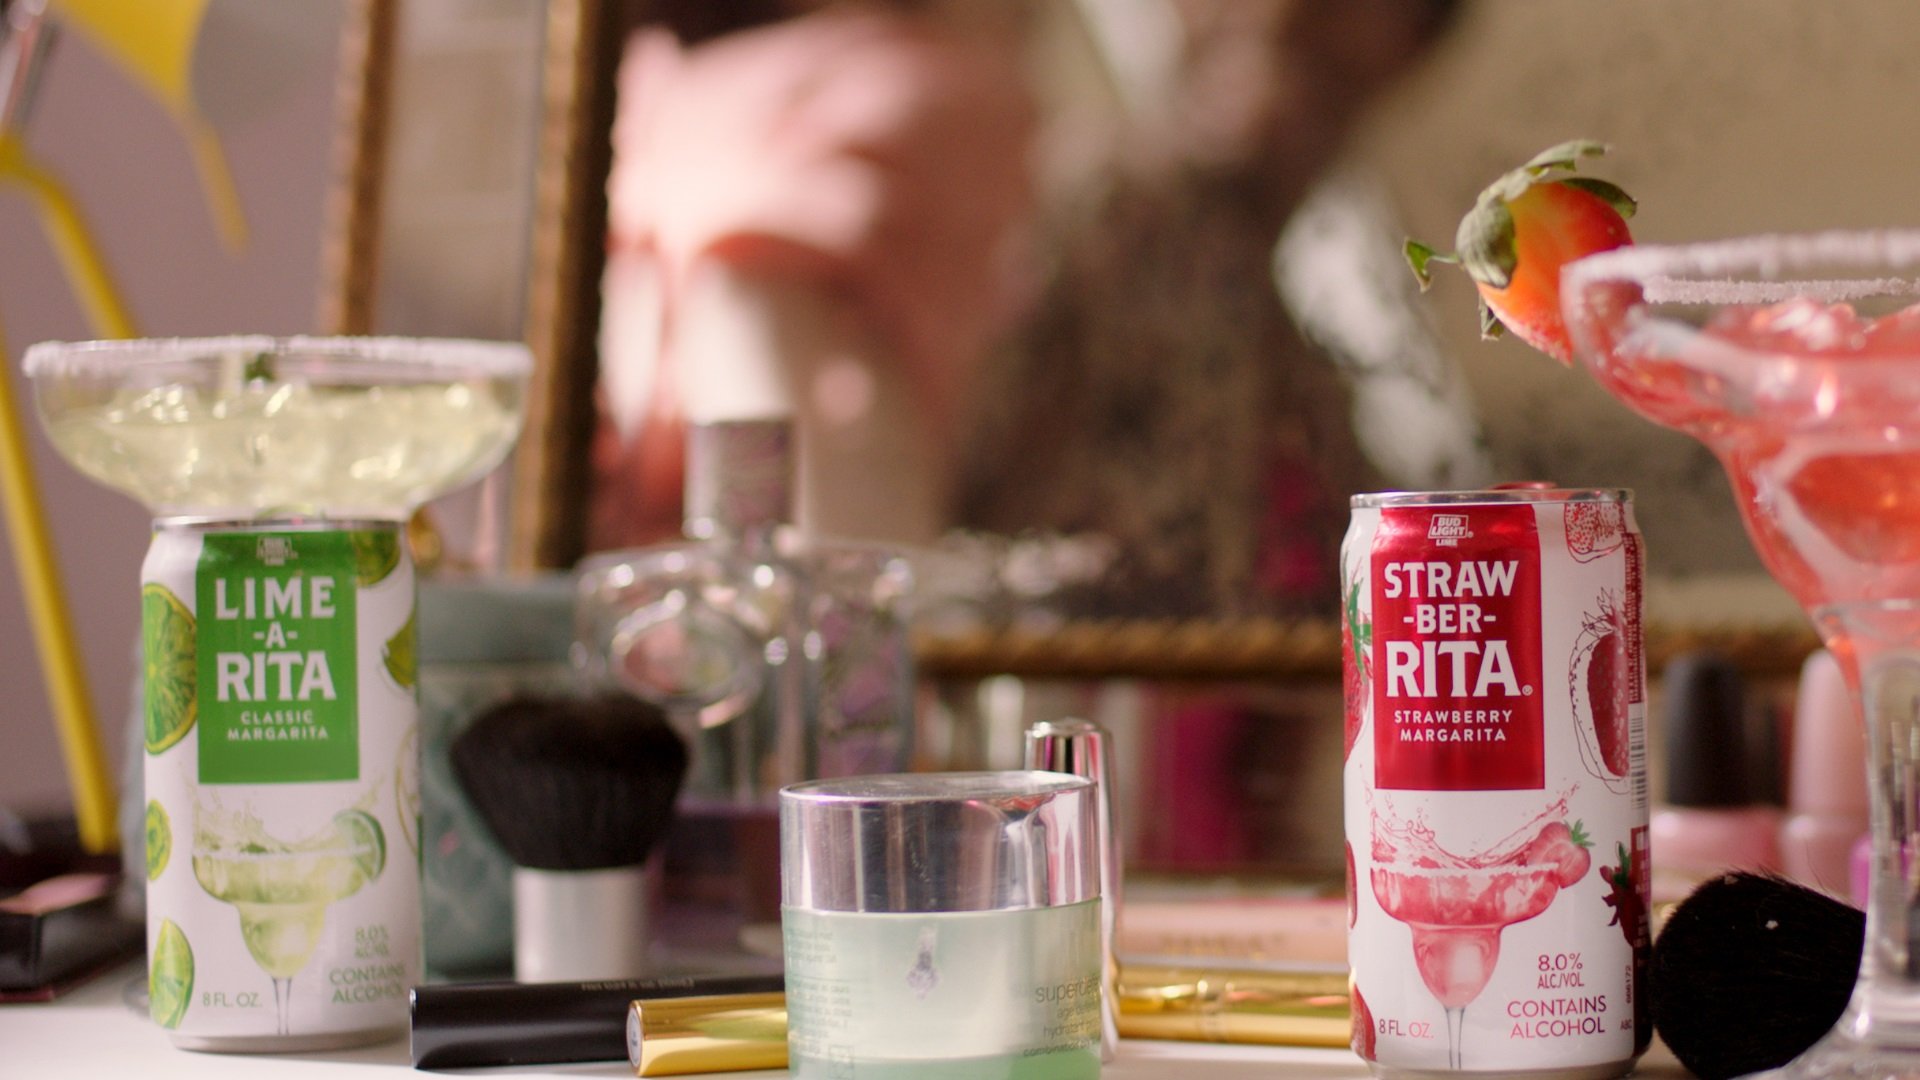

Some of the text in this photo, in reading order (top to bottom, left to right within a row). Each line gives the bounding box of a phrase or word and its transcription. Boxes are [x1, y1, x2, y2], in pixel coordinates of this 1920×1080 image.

[1431, 526, 1465, 536] LIGHT
[1438, 517, 1462, 527] BUD
[1384, 560, 1519, 598] STRAW
[215, 576, 336, 620] LIME
[1403, 603, 1497, 634] -BER-
[253, 622, 298, 648] -A-
[217, 650, 337, 702] RITA
[241, 710, 313, 725] CLASSIC
[1394, 709, 1513, 724] STRAWBERRY
[227, 727, 329, 741] MARGARITA
[1400, 728, 1506, 742] MARGARITA
[1538, 953, 1583, 971] 8.0%
[1507, 995, 1607, 1018] CONTAINS
[1379, 1018, 1386, 1034] 8
[1409, 1022, 1434, 1038] OZ.
[1510, 1017, 1606, 1039] ALCOHOL
